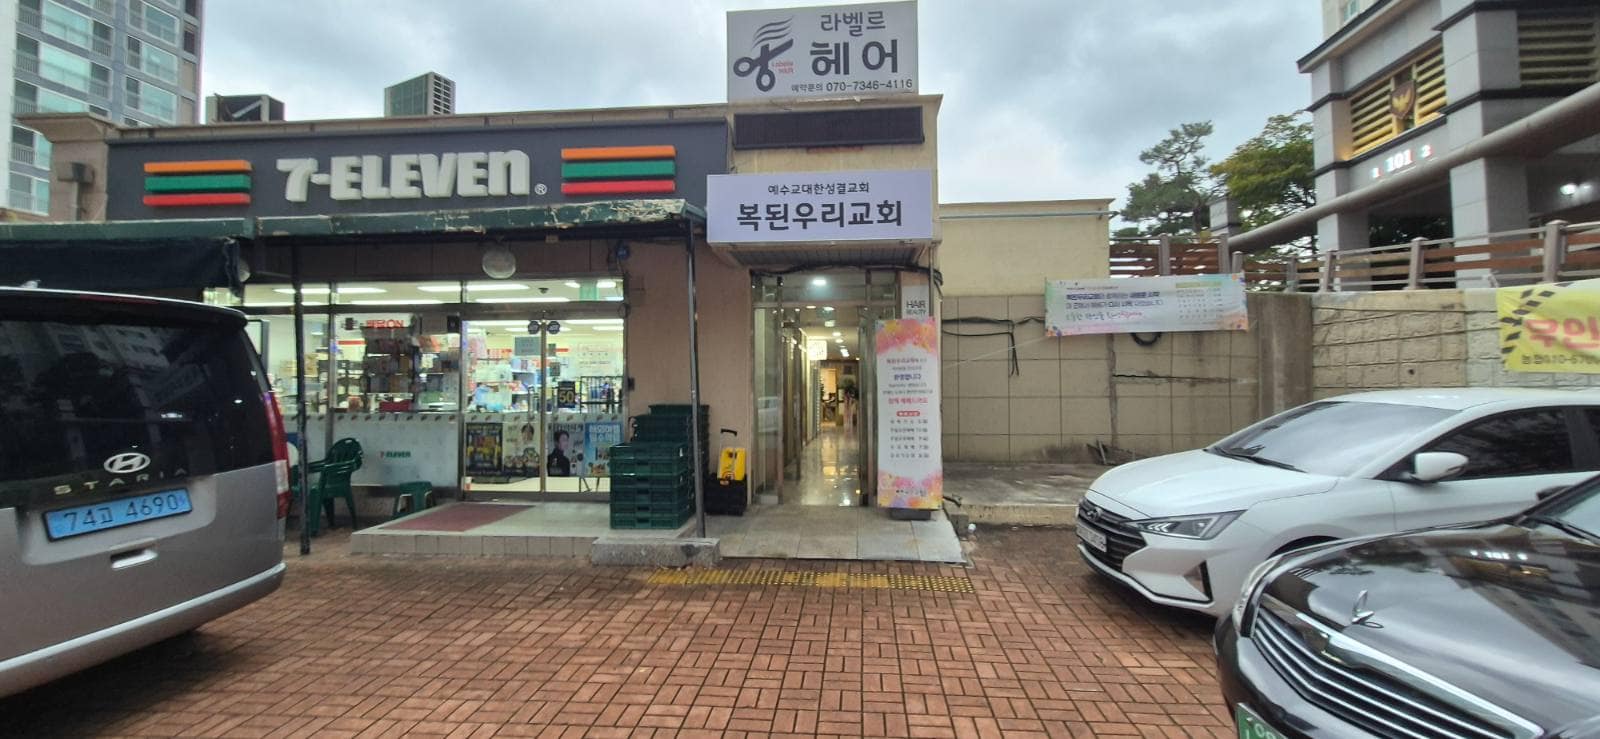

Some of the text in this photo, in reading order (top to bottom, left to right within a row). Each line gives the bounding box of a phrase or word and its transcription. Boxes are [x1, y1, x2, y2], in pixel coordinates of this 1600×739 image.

[820, 10, 886, 37] 라벨르
[810, 39, 898, 76] 헤어
[826, 79, 913, 92] 070-7346-4116
[1385, 149, 1413, 171] 101
[276, 149, 530, 202] 7-ELEVEN
[768, 182, 870, 195] 예수교대한성결교회
[737, 200, 902, 231] 복된우리교회
[906, 300, 926, 308] HAIR
[54, 468, 188, 495] STARIA
[126, 494, 178, 517] 4690
